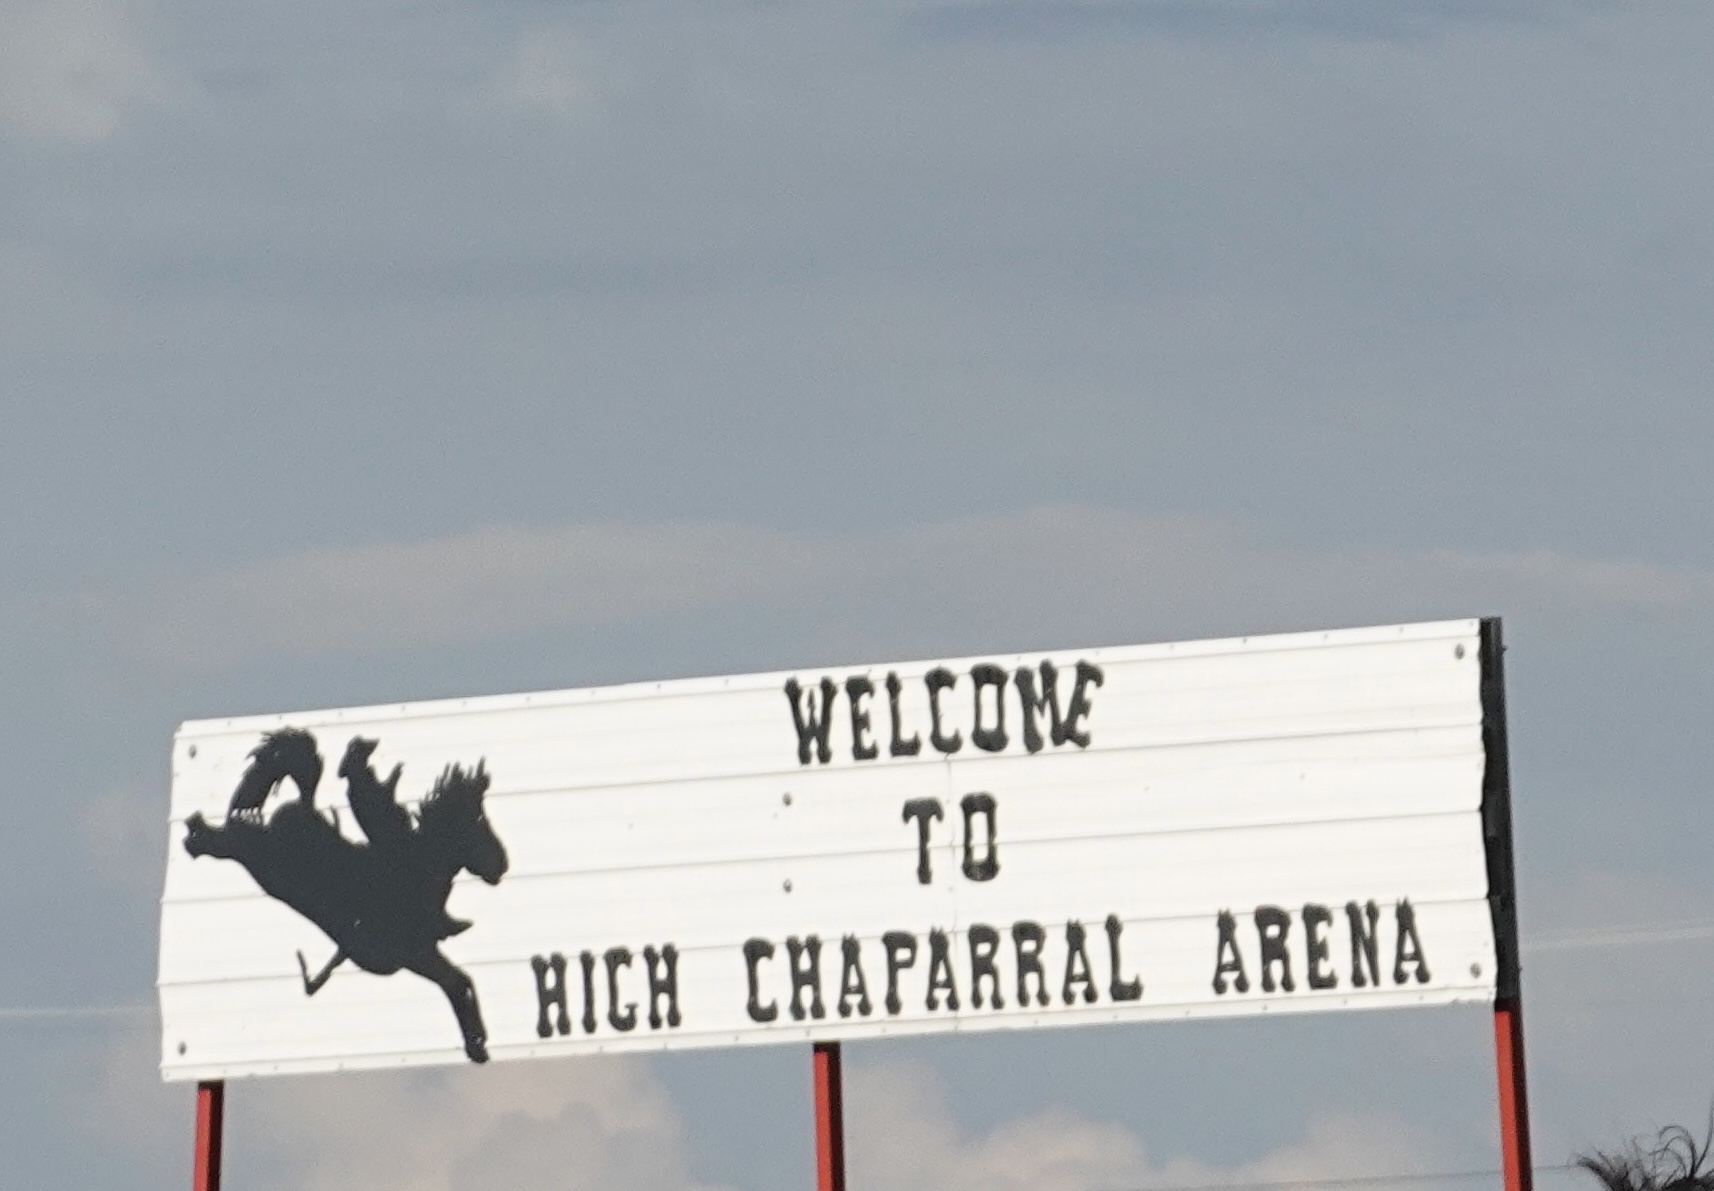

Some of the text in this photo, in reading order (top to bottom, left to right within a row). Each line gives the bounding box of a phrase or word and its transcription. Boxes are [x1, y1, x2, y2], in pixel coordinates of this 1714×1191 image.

[785, 660, 1104, 766] WELCOME
[902, 792, 1000, 884] TO
[531, 898, 1431, 1038] HIGH CHAPARRAL ARENA
